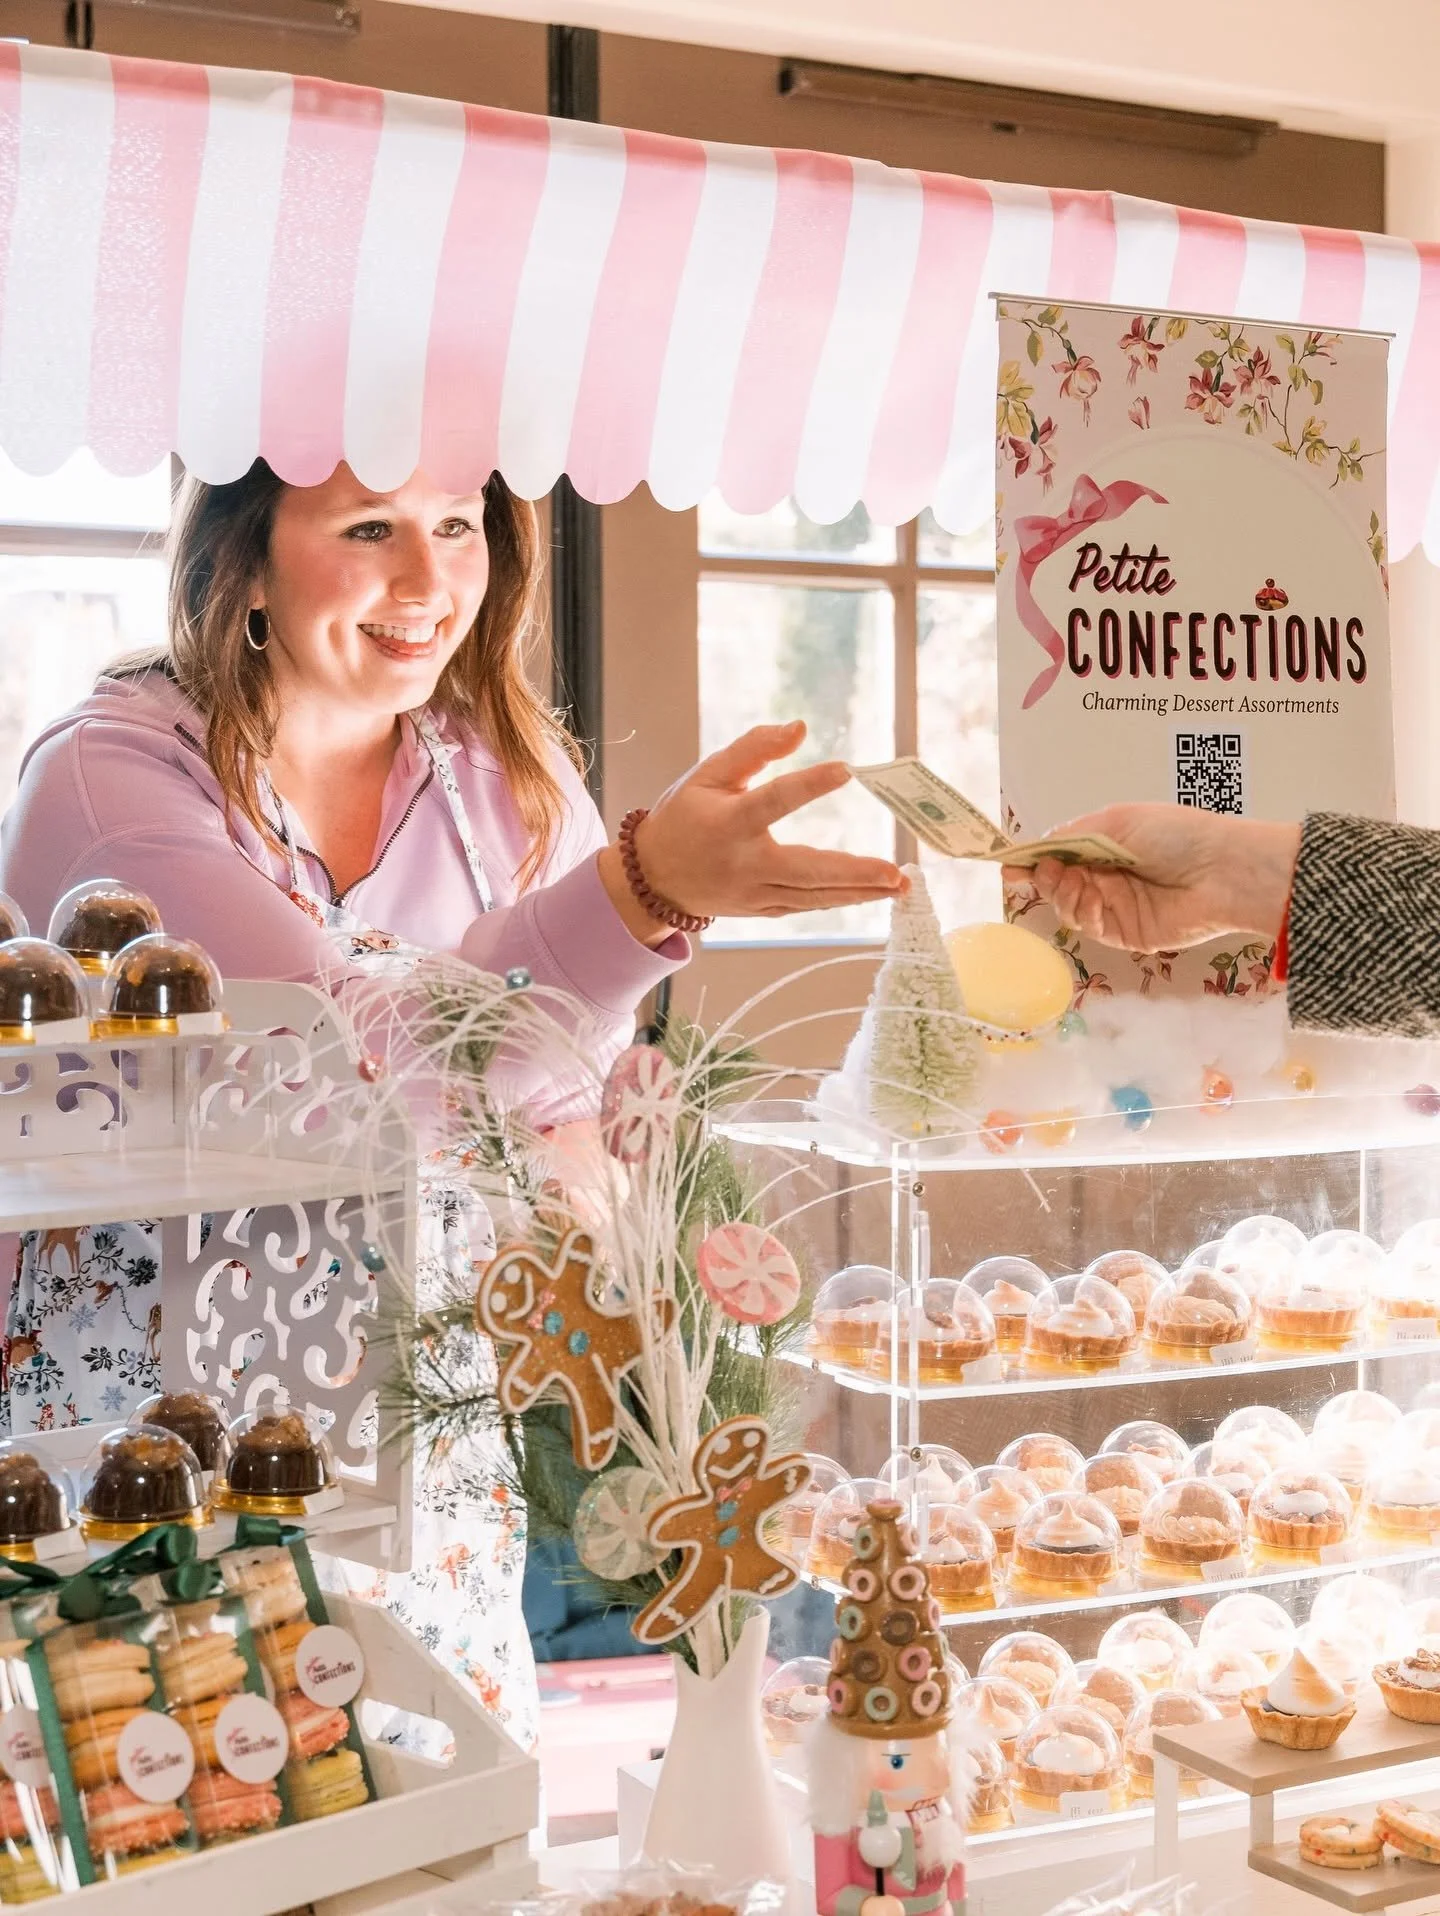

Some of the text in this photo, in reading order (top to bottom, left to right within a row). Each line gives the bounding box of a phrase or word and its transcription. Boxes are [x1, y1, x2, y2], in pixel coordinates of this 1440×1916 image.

[1068, 542, 1177, 596] Petite
[1068, 607, 1367, 684] CONFECTIONS
[1082, 692, 1340, 716] Charming Dessert Assortments
